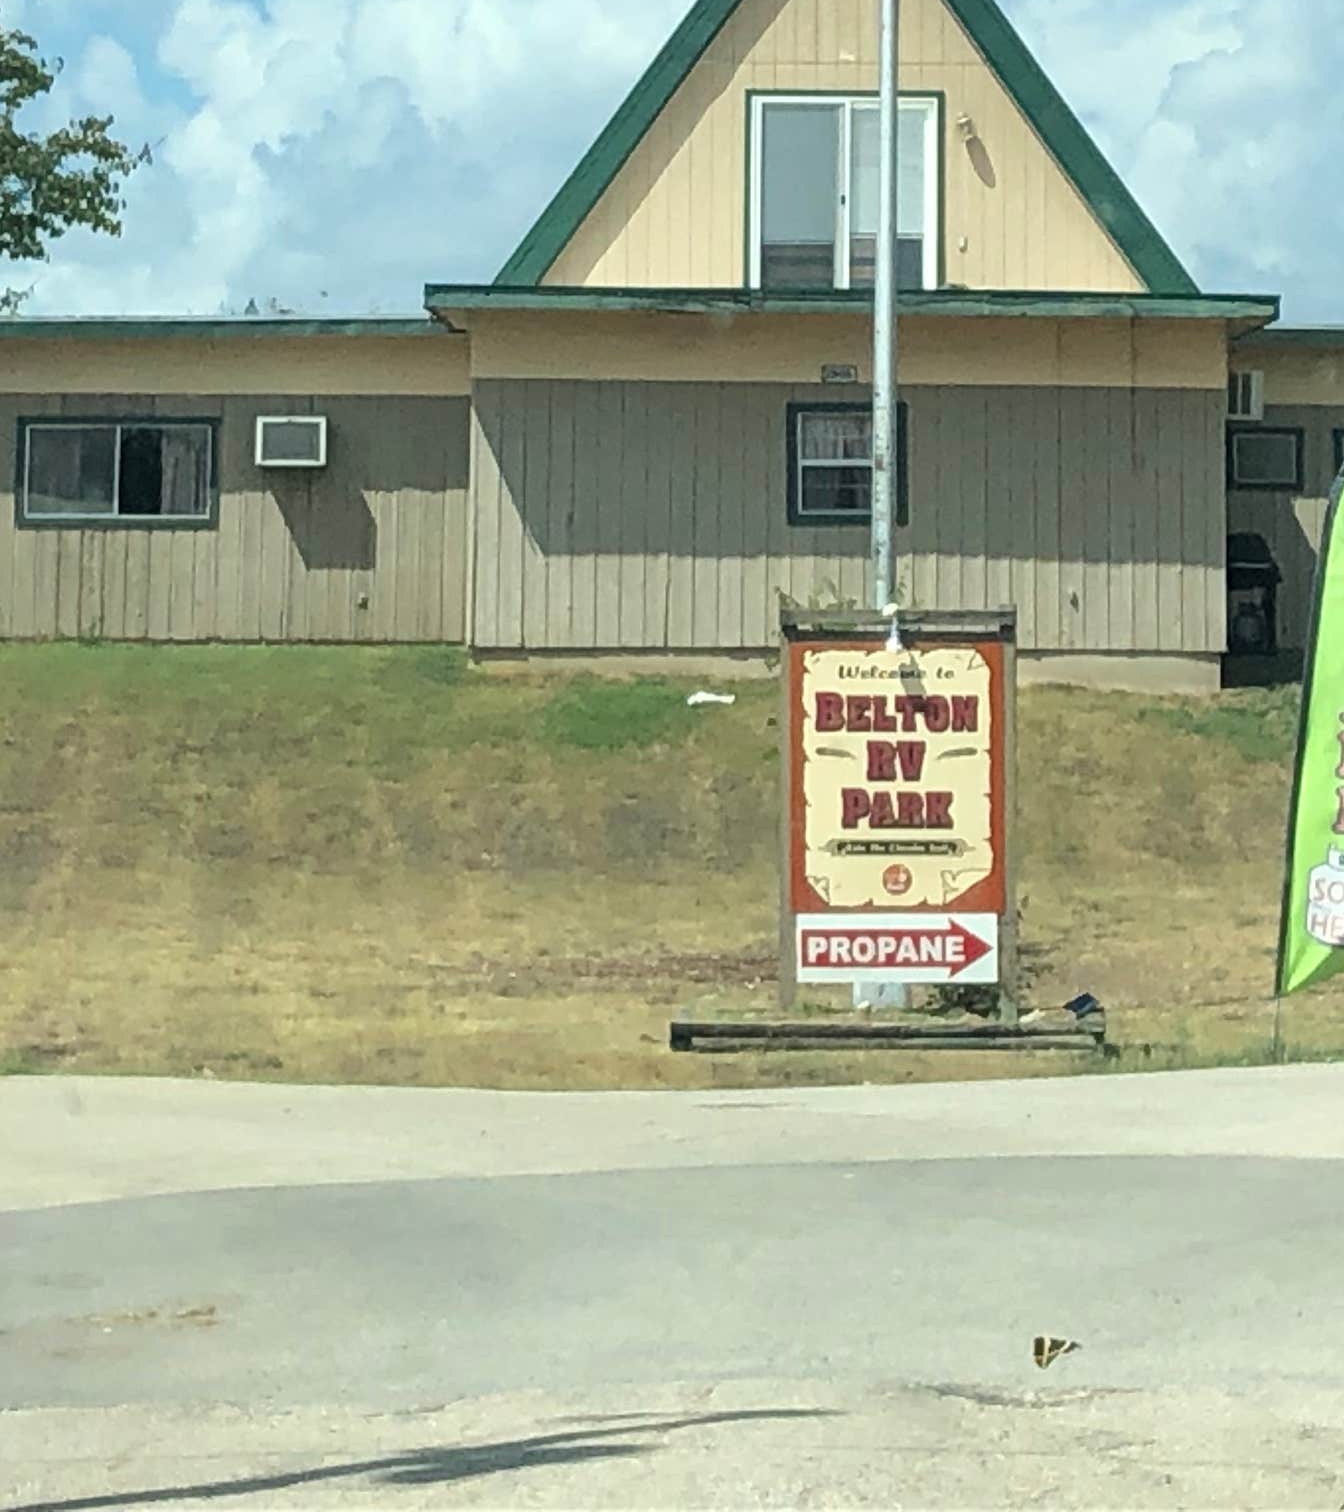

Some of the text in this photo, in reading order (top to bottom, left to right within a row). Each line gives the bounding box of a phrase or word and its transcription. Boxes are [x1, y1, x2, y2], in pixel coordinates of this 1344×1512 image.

[838, 665, 955, 680] Welcome to
[815, 691, 979, 732] BELTON
[866, 740, 926, 782] RV
[841, 787, 954, 829] PARK
[807, 936, 966, 963] PROPANE
